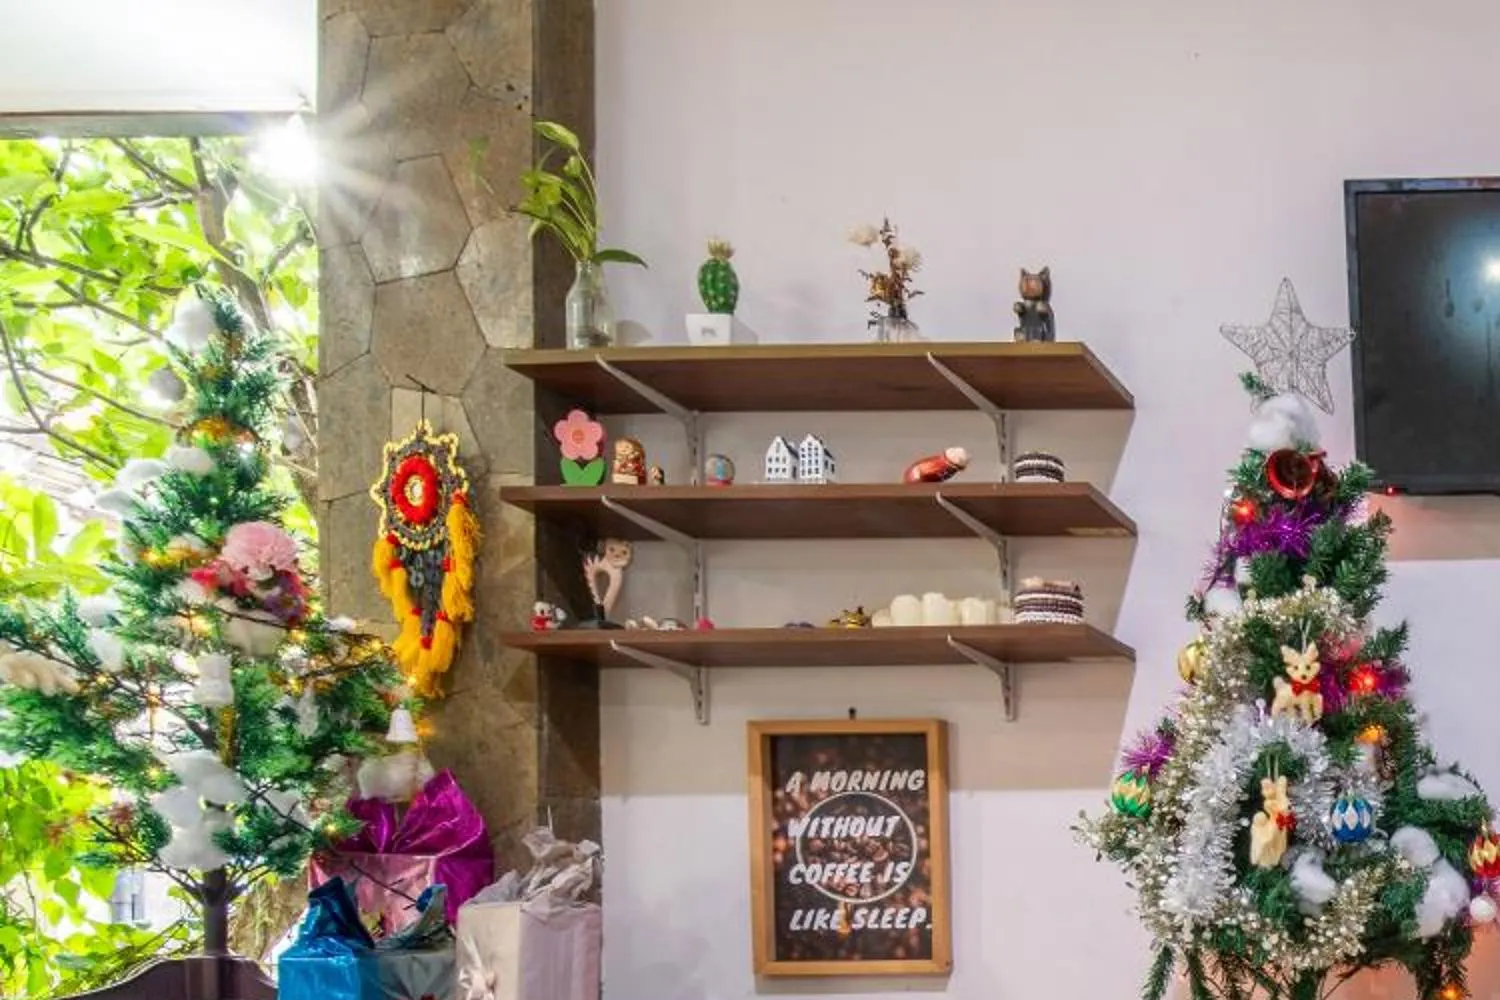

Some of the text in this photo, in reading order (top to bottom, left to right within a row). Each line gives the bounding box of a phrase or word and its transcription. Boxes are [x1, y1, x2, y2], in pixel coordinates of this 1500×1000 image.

[786, 769, 926, 793] A MORNING
[787, 815, 901, 839] WITHOUT
[788, 862, 911, 885] COFFEE IS
[789, 909, 844, 931] LIKE
